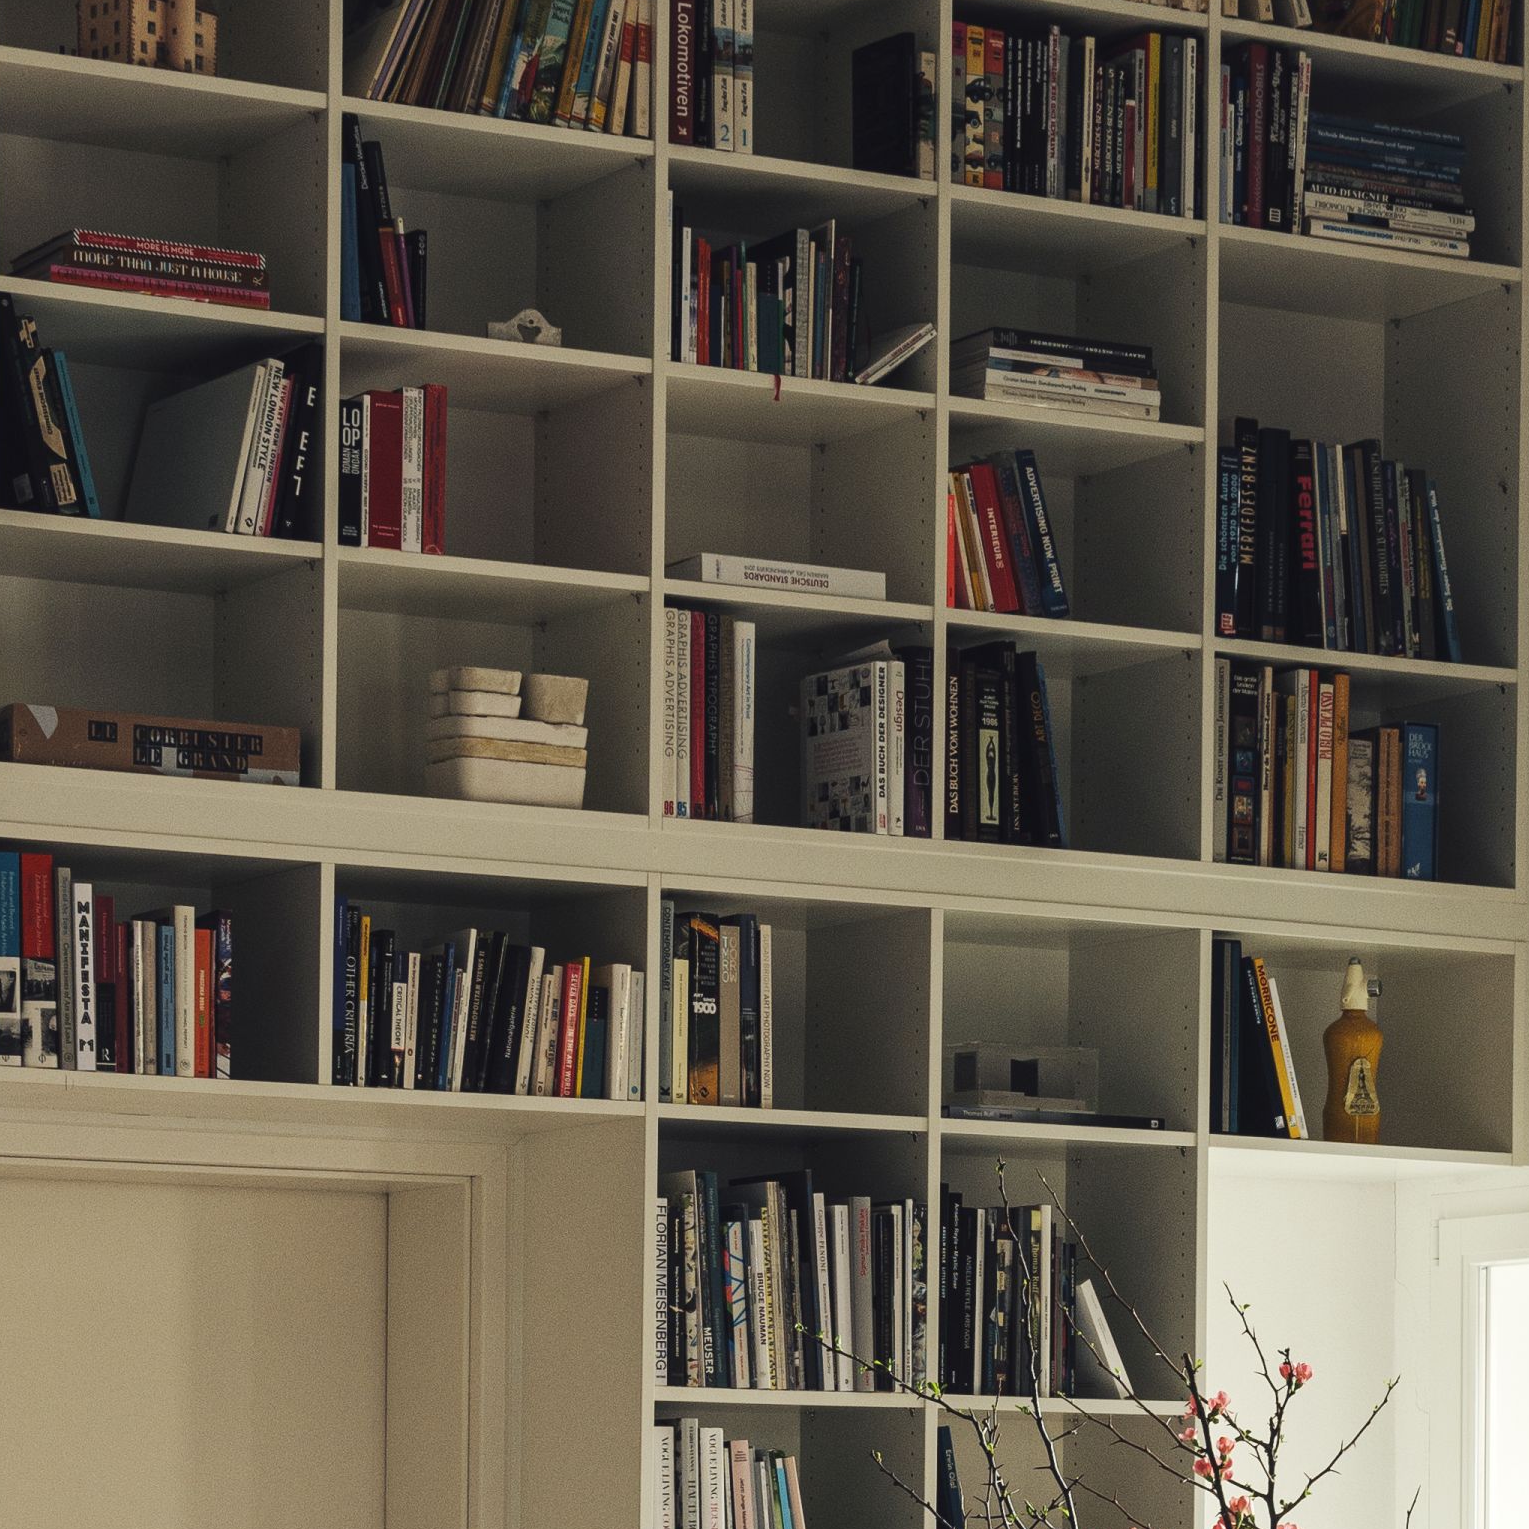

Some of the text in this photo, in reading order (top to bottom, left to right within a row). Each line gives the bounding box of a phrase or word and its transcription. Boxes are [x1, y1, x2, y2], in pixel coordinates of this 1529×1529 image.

[677, 2, 692, 117] Lokomotiven
[1311, 184, 1389, 202] AUTO-DESIGNER
[74, 251, 242, 283] MORE THAN JUST A HOUSE
[136, 242, 160, 251] MORE
[170, 246, 194, 256] MORE
[258, 366, 282, 470] NEW LONDON STYLE
[279, 384, 287, 404] NEW
[266, 449, 277, 483] LONDON
[273, 424, 281, 446] FROM
[1025, 467, 1046, 534] ADVERTISING
[1048, 563, 1063, 593] PRINT
[1220, 504, 1228, 552] schönsten
[1240, 446, 1256, 564] MERCEDES-BENZ
[1297, 474, 1317, 569] Ferrari
[987, 507, 1004, 569] INTERIEURS
[665, 611, 675, 757] GRAPHIS ADVERTISING
[677, 613, 686, 759] GRAPHIS ADVERTISING
[708, 615, 717, 756] GRAPHIS TYPOGRAPHY
[894, 690, 903, 732] Design
[89, 721, 263, 755] LE CORBUSIER
[913, 657, 931, 785] DER STUHL
[949, 676, 958, 813] DAS BUCH VOM WOHNEN
[1319, 691, 1333, 759] PABLO PICASSO
[133, 745, 248, 773] LE GRAND
[344, 956, 356, 1053] OTHER CRITERIA
[394, 985, 403, 1047] CRITICAL THEORY
[570, 973, 578, 997] SEVEN
[1256, 965, 1279, 1042] MORRICONE
[563, 1071, 571, 1095] WORLD
[565, 1055, 573, 1069] ART
[656, 1205, 666, 1370] FLORIAN MEISENBERG
[704, 1327, 713, 1374] MEUSER
[688, 1480, 697, 1518] HAUTE
